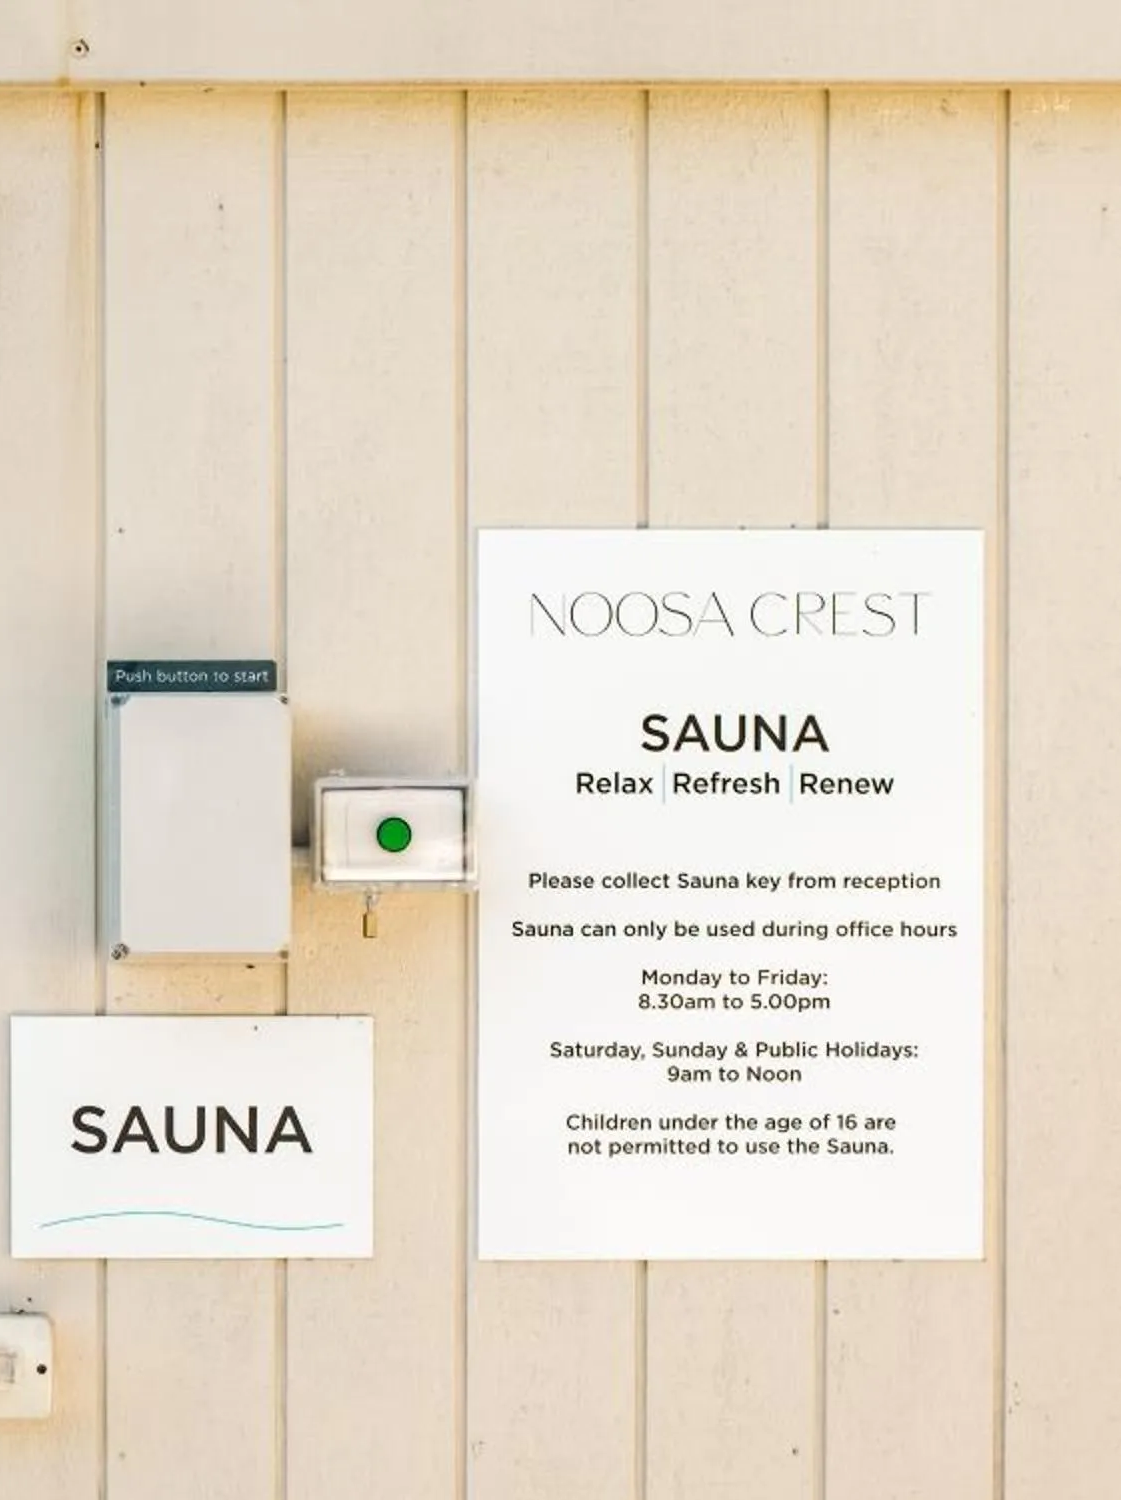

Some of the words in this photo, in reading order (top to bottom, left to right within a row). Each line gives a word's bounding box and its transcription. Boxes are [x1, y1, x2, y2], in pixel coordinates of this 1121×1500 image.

[529, 591, 736, 637] NOOSA
[749, 591, 929, 637] CREST
[115, 669, 152, 683] Push
[156, 669, 208, 683] button
[213, 671, 229, 683] to
[234, 671, 270, 683] start
[641, 713, 830, 753] SAUNA
[576, 771, 653, 795] Relax
[673, 771, 780, 795] Refresh
[800, 772, 894, 795] Renew
[528, 871, 596, 890] Please
[601, 871, 671, 889] collect
[677, 872, 740, 889] Sauna
[746, 871, 782, 893] key
[787, 871, 837, 889] from
[843, 872, 941, 893] reception
[511, 920, 574, 938] Sauna
[580, 923, 617, 938] can
[622, 919, 668, 941] only
[673, 920, 700, 938] be
[706, 920, 756, 938] used
[761, 920, 829, 941] during
[835, 920, 894, 938] office
[900, 920, 958, 938] hours
[641, 968, 723, 989] Monday
[728, 969, 751, 986] to
[757, 968, 828, 989] Friday:
[638, 992, 716, 1010] 8.30am
[722, 994, 744, 1010] to
[750, 993, 831, 1013] 5.00pm
[550, 1041, 646, 1062] Saturday,
[652, 1041, 728, 1062] Sunday
[734, 1041, 748, 1059] &
[755, 1041, 818, 1059] Public
[825, 1041, 919, 1062] Holidays:
[667, 1065, 712, 1083] 9am
[718, 1066, 740, 1083] to
[746, 1065, 802, 1083] Noon
[71, 1105, 313, 1155] SAUNA
[566, 1113, 652, 1131] Children
[658, 1113, 720, 1131] under
[724, 1113, 759, 1131] the
[764, 1117, 803, 1134] age
[808, 1113, 831, 1131] of
[836, 1113, 858, 1131] 16
[863, 1117, 897, 1131] are
[567, 1138, 602, 1155] not
[608, 1137, 711, 1158] permitted
[716, 1139, 739, 1155] to
[745, 1141, 781, 1155] use
[786, 1137, 820, 1155] the
[826, 1137, 894, 1155] Sauna.
